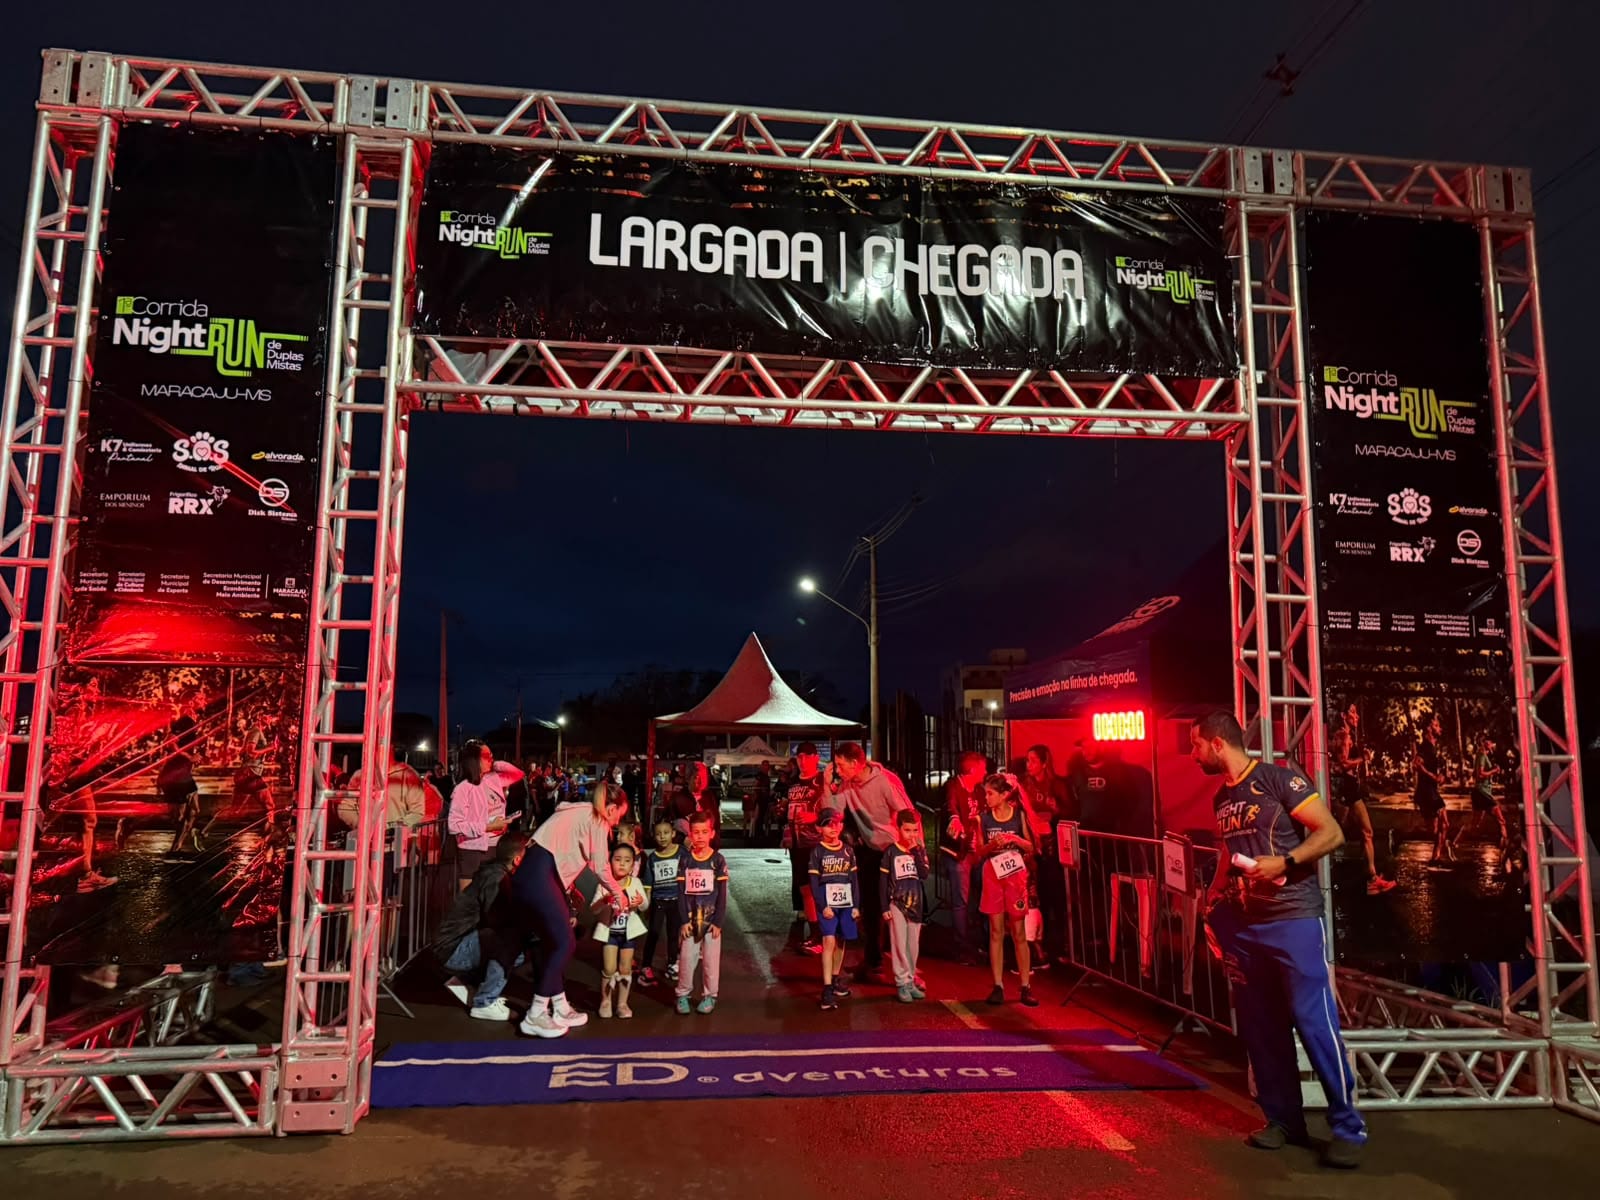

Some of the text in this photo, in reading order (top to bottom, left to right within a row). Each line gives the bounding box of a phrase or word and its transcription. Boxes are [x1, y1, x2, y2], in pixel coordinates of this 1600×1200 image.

[450, 211, 495, 225] Corrida
[439, 224, 495, 246] Night
[589, 212, 1085, 299] LARGADA CHEGADA
[1125, 257, 1164, 270] Corrida
[1116, 268, 1165, 290] Night
[132, 296, 208, 317] Corrida
[112, 317, 265, 377] Night RUN
[267, 340, 282, 350] de
[266, 350, 304, 361] Duplas
[266, 360, 302, 371] Mistas
[1336, 366, 1398, 386] Corrida
[1324, 385, 1399, 418] Night
[1446, 407, 1458, 415] de
[1447, 416, 1476, 426] Duplas
[1448, 425, 1476, 434] Mistas
[100, 439, 122, 453] K7
[100, 493, 151, 502] EMPORIUM
[1329, 493, 1347, 505] K7
[168, 497, 214, 516] RRX
[1335, 541, 1376, 550] EMPORIUM
[1390, 547, 1425, 563] RRX
[1009, 688, 1032, 703] Precisão
[1036, 680, 1060, 698] emoção
[1070, 675, 1087, 689] linha
[1088, 673, 1098, 687] de
[1099, 668, 1138, 689] chegada.
[822, 857, 844, 866] NIGHT
[1000, 859, 1017, 871] 182
[659, 867, 674, 877] 153
[690, 878, 706, 889] 164
[832, 892, 847, 902] 234
[733, 1066, 1018, 1083] aventuras
